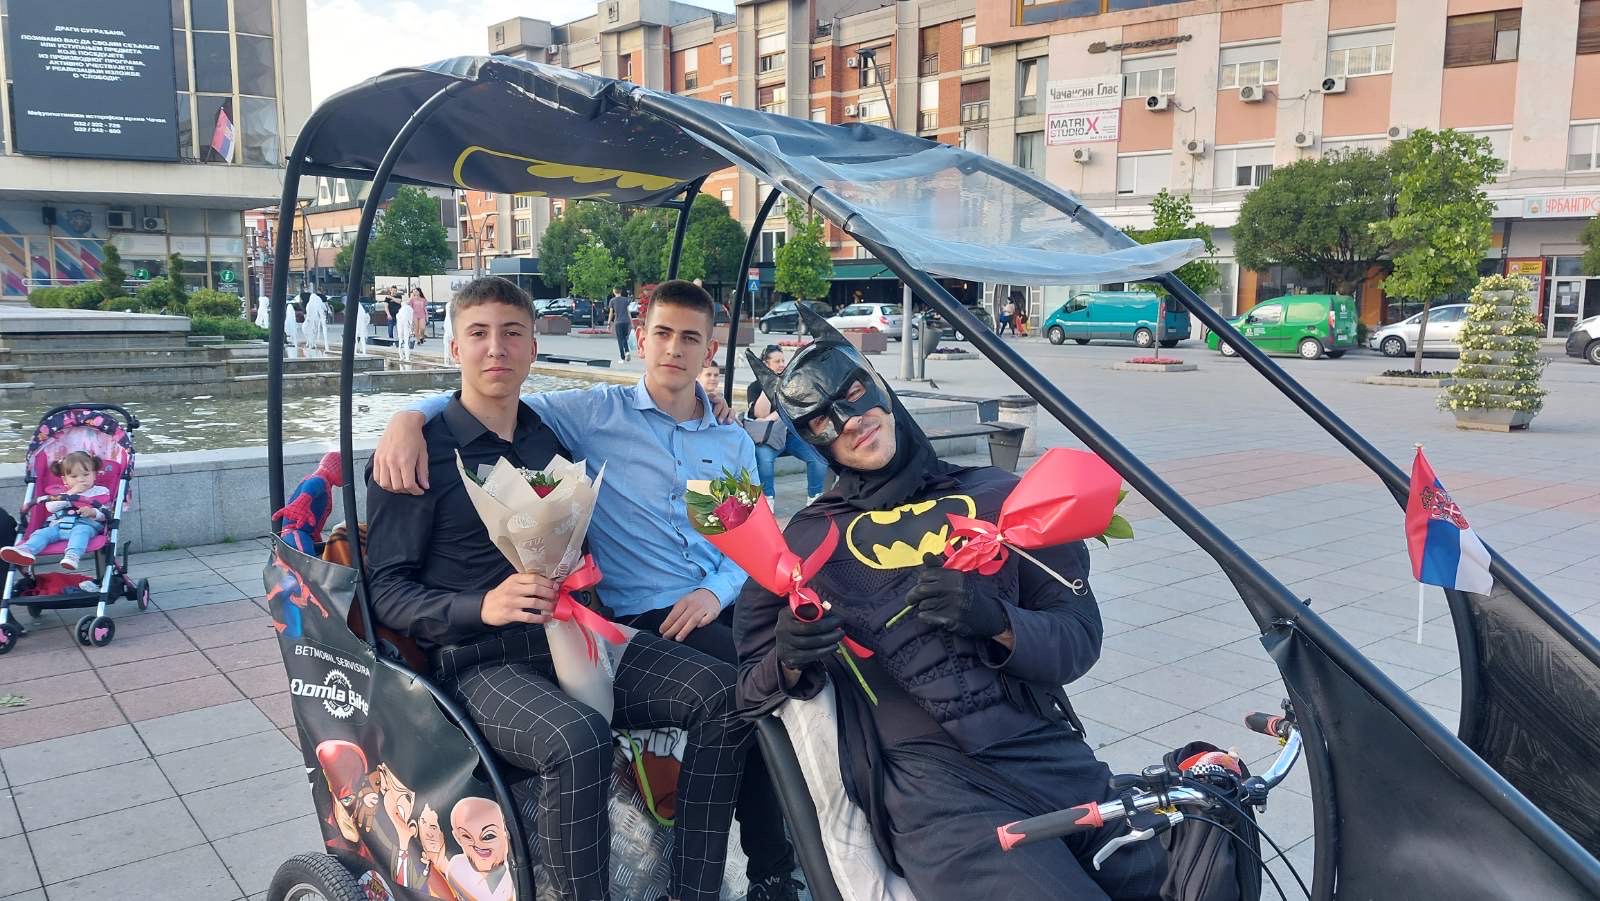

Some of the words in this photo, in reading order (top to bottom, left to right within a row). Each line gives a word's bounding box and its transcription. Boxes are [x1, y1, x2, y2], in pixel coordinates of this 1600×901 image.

[1097, 83, 1119, 96] Глас
[1050, 127, 1085, 138] STUDIO
[295, 645, 336, 663] BETMOBIL
